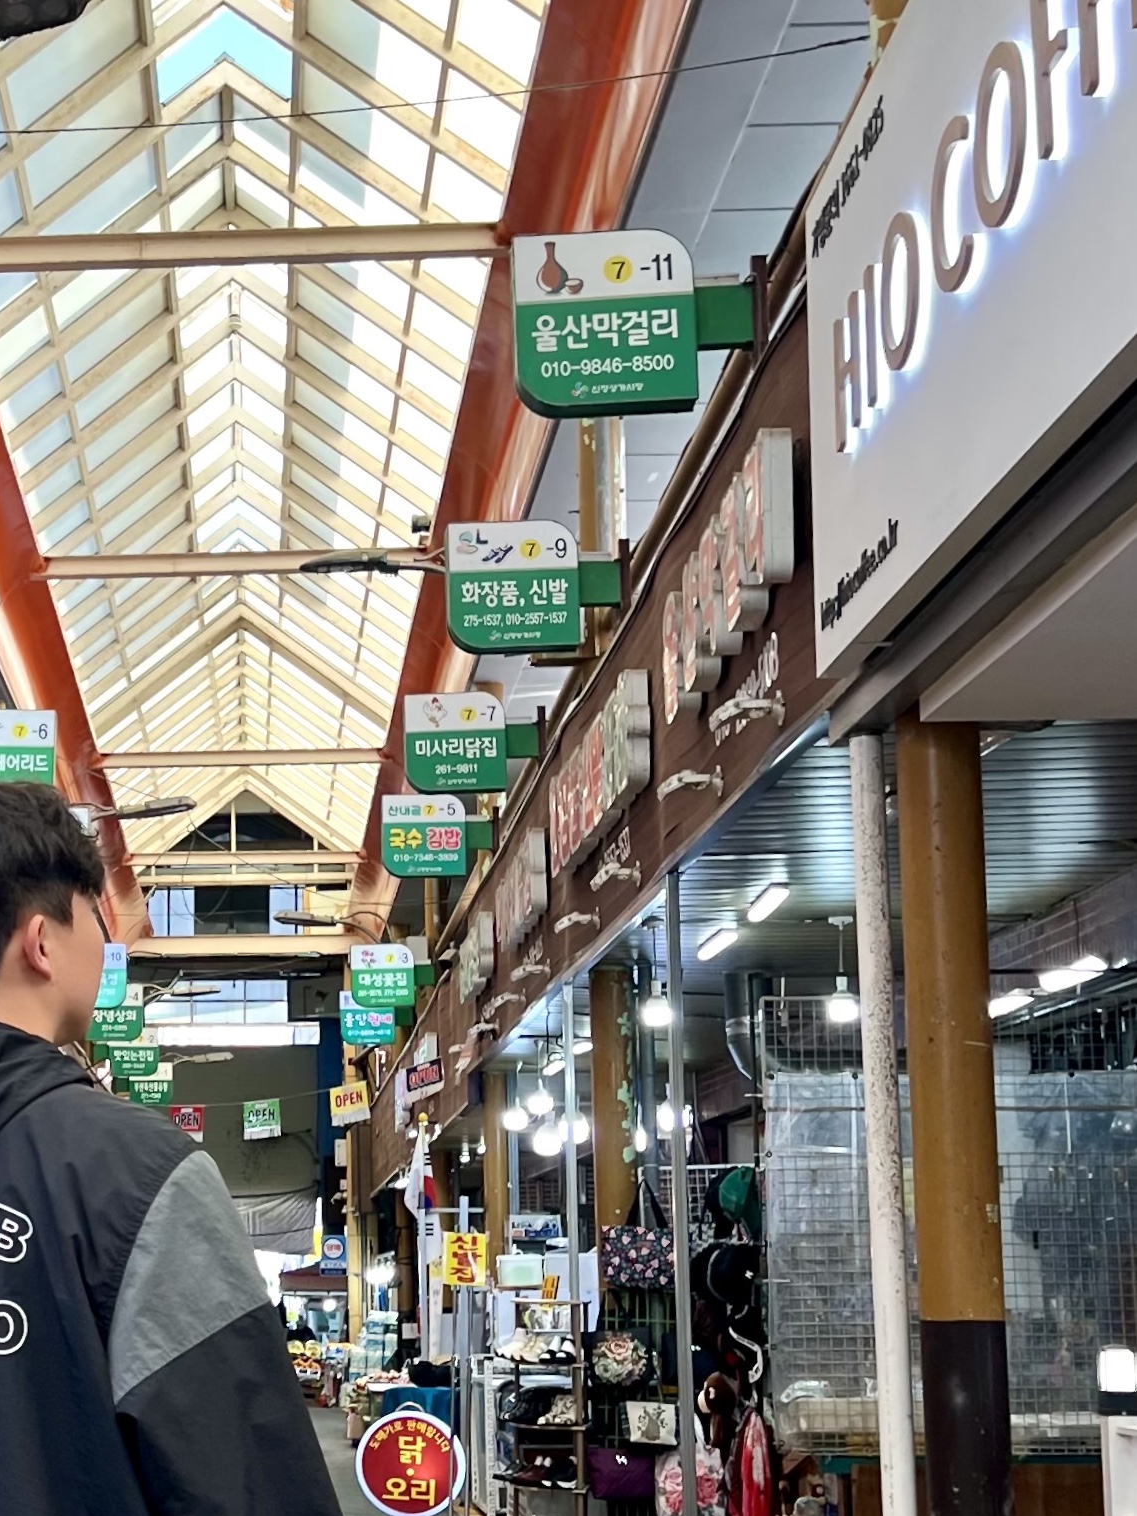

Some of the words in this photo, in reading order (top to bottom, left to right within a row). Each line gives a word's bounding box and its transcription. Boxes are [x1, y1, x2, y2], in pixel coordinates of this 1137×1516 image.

[531, 309, 679, 352] 울산막걸리
[541, 354, 674, 378] 010-9846-8500
[529, 578, 568, 605] 신발
[415, 737, 497, 758] 미사리닭집
[389, 827, 423, 850] 국수
[427, 826, 463, 851] 김밥
[335, 1090, 363, 1108] OPEN
[174, 1112, 199, 1127] OPEN
[248, 1108, 276, 1123] OPEN
[398, 1435, 427, 1465] 닭
[381, 1477, 436, 1507] 오리
